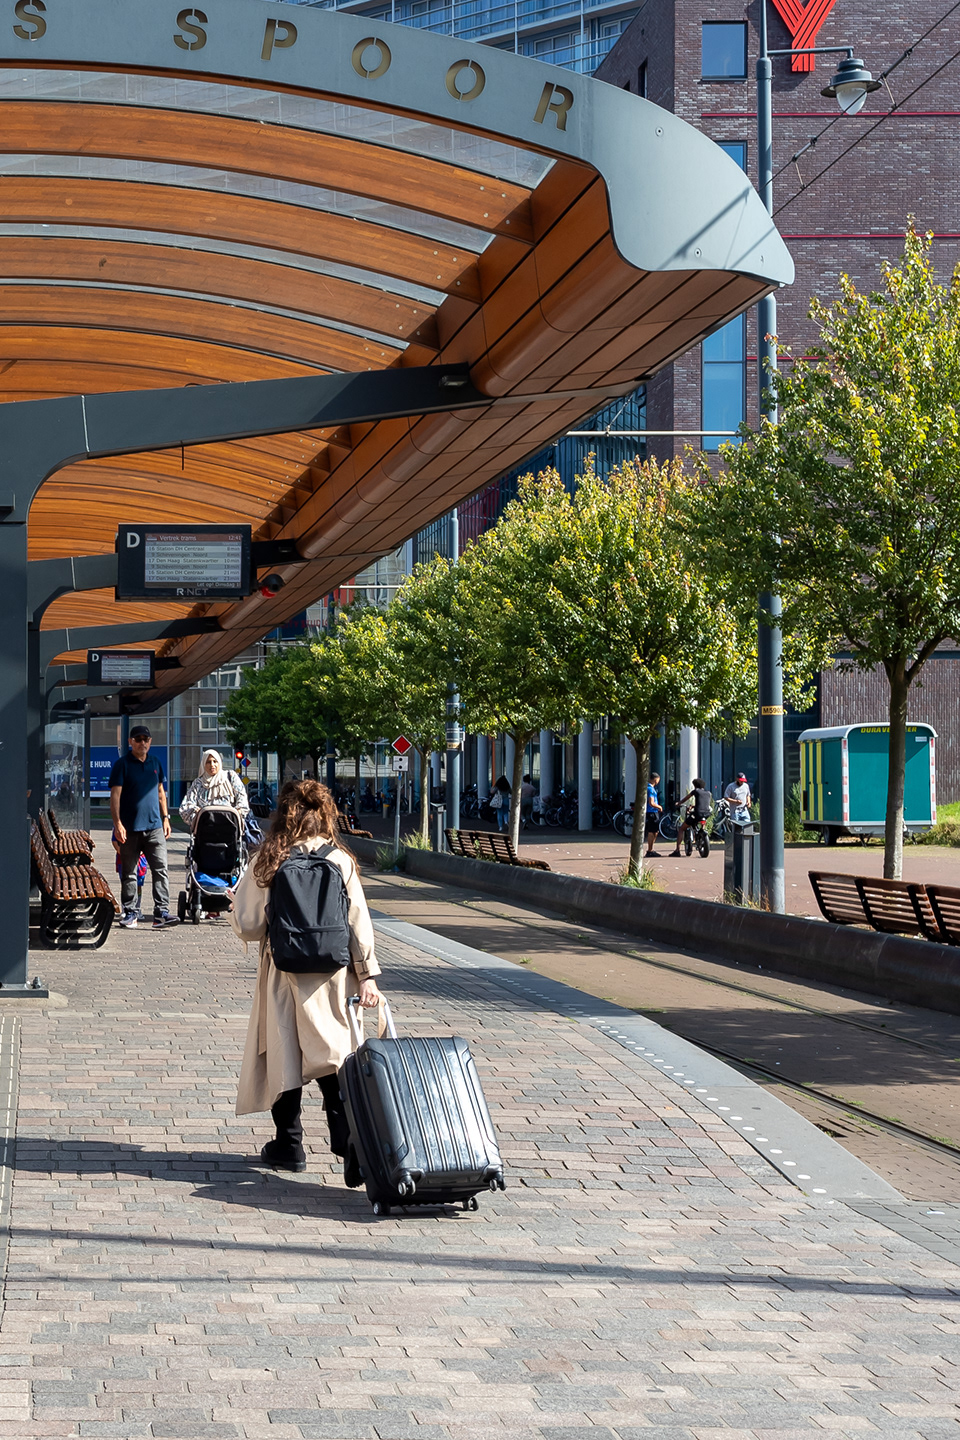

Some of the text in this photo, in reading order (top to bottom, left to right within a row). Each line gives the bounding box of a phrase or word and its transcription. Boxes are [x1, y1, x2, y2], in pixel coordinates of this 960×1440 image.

[173, 8, 575, 131] SPOOR
[126, 532, 140, 548] D
[91, 653, 100, 662] D
